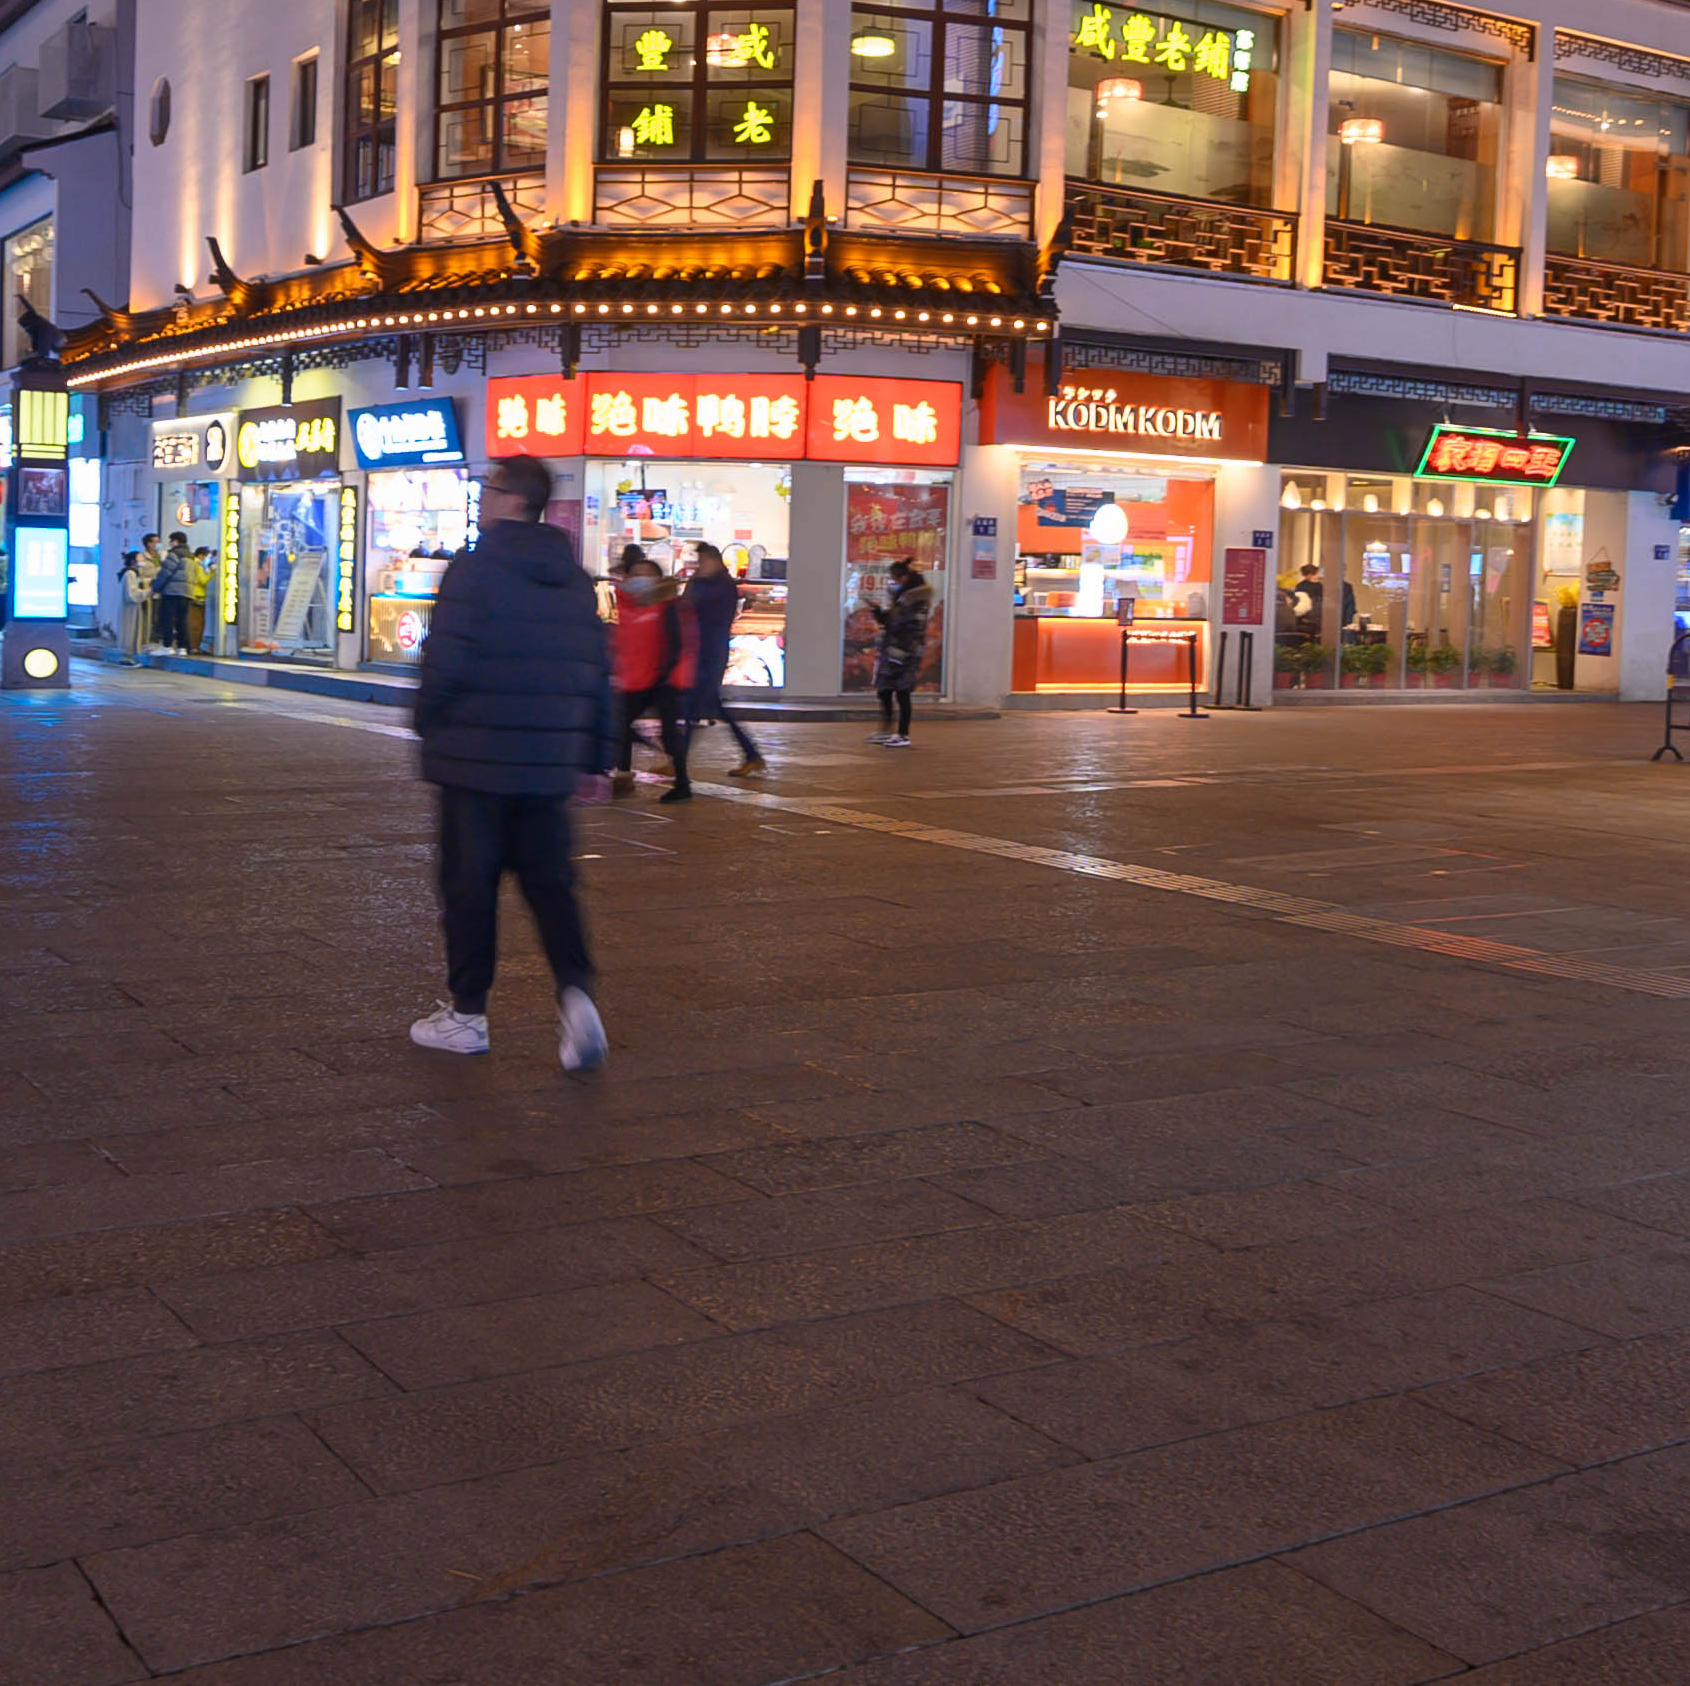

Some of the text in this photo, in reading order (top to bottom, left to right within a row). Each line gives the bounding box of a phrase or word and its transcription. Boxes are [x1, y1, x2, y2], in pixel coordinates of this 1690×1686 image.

[1074, 3, 1232, 80] 咸豐老鋪
[497, 394, 567, 439] 绝味
[590, 390, 800, 438] 绝味鸭脖
[833, 396, 938, 445] 绝味
